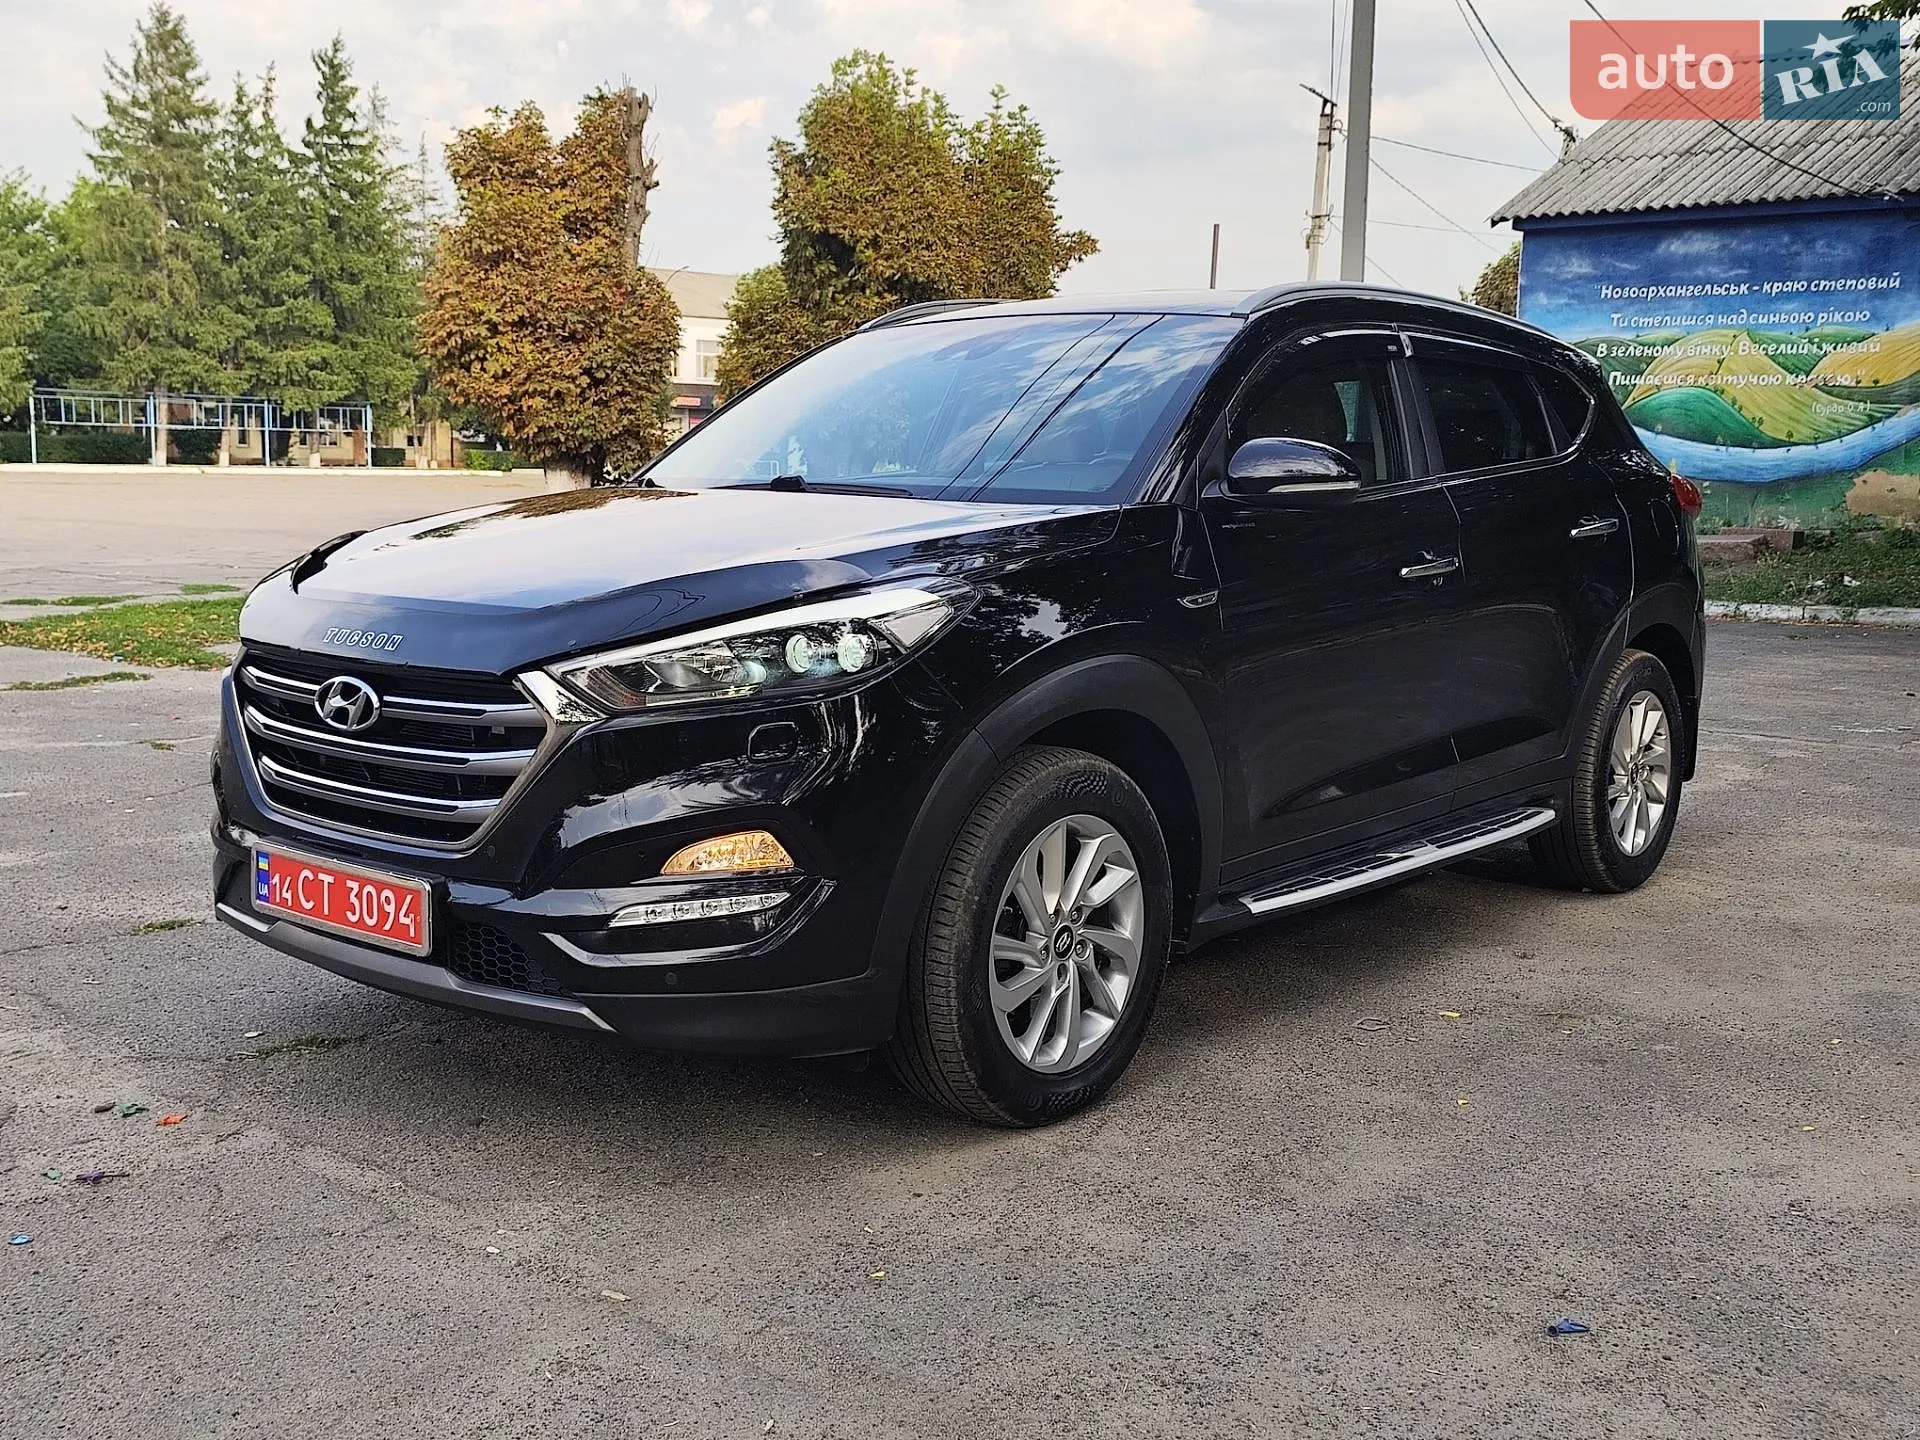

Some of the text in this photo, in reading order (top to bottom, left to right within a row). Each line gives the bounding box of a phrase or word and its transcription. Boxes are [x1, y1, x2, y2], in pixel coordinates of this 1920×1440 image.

[1762, 279, 1808, 297] краю
[1810, 271, 1901, 292] степовий
[1610, 307, 1871, 328] Ти стелишся над синьою рікою
[1596, 343, 1608, 358] В
[1610, 345, 1686, 360] зеленому
[1738, 339, 1809, 356] Веселий
[323, 628, 404, 651] TUCSON
[258, 882, 269, 897] UA
[345, 879, 415, 939] 3094
